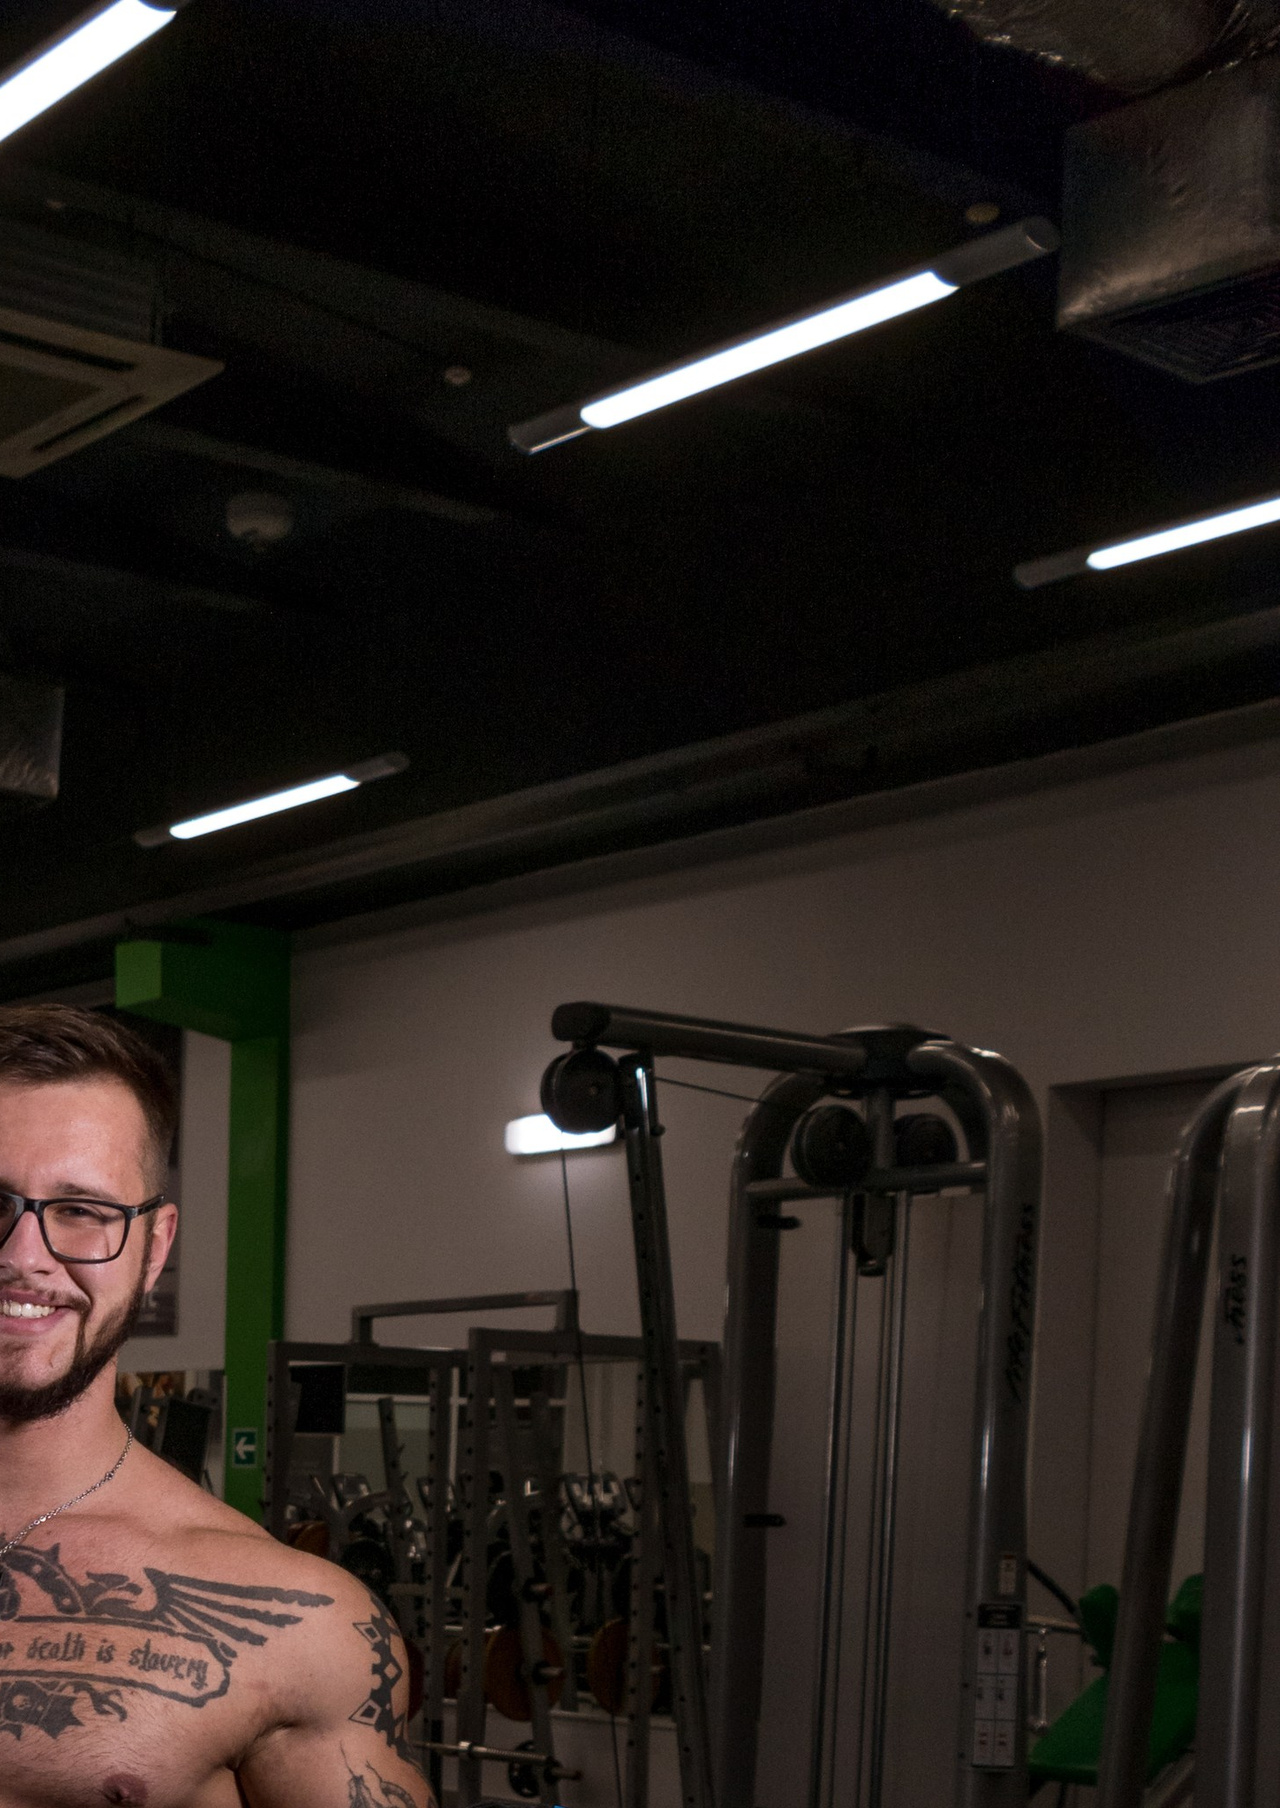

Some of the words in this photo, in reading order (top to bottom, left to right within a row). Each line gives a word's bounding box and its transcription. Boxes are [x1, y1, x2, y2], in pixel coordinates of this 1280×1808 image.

[27, 1632, 87, 1662] death
[96, 1638, 116, 1664] is
[128, 1637, 209, 1691] slavery
